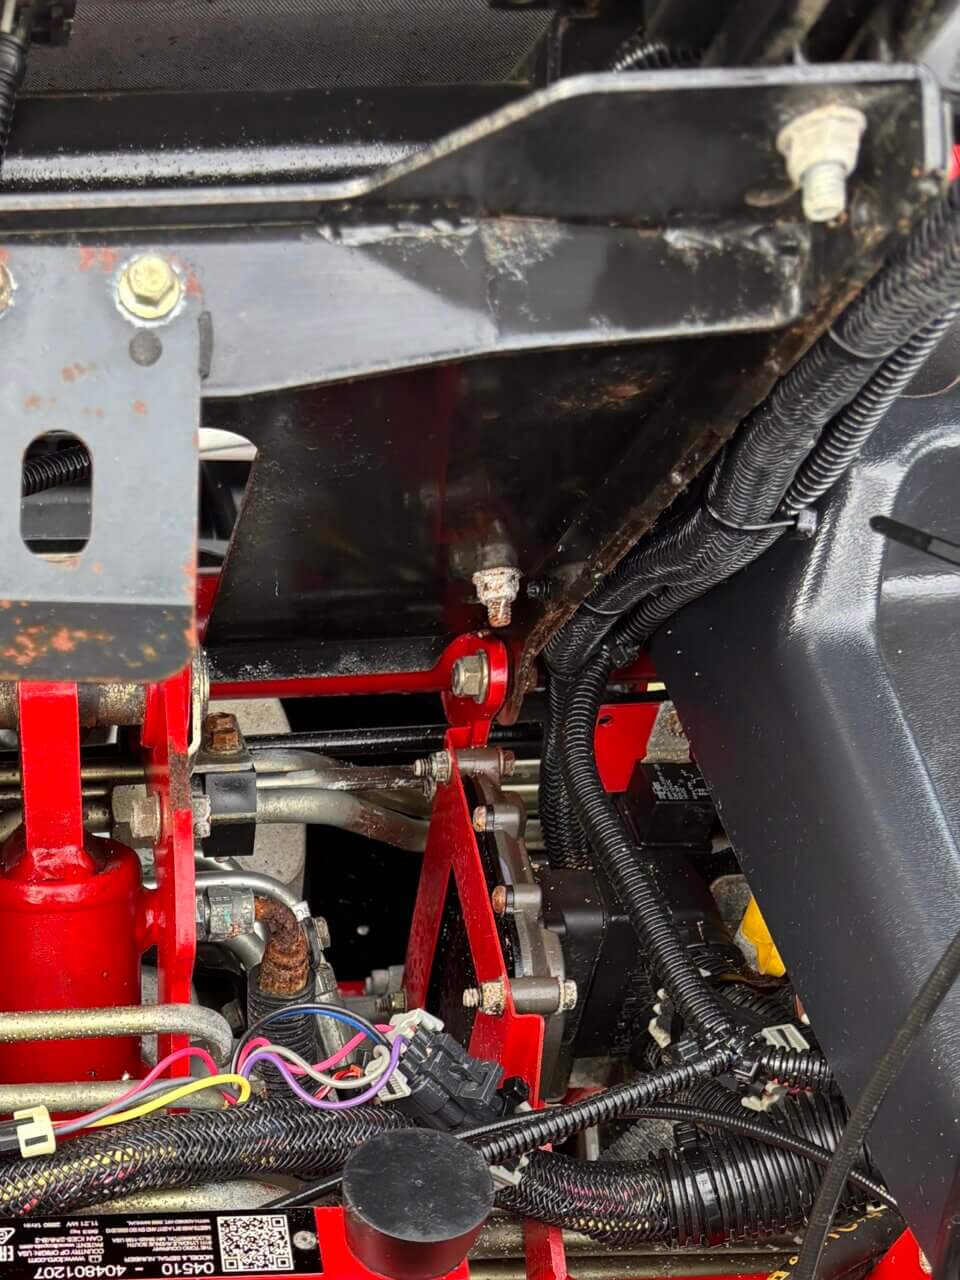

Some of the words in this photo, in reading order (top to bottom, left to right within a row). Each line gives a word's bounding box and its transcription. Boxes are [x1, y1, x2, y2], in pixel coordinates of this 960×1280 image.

[16, 1250, 33, 1258] USA
[27, 1256, 86, 1264] www.toro.com
[33, 1264, 127, 1279] 404801207
[161, 1262, 215, 1276] 04510
